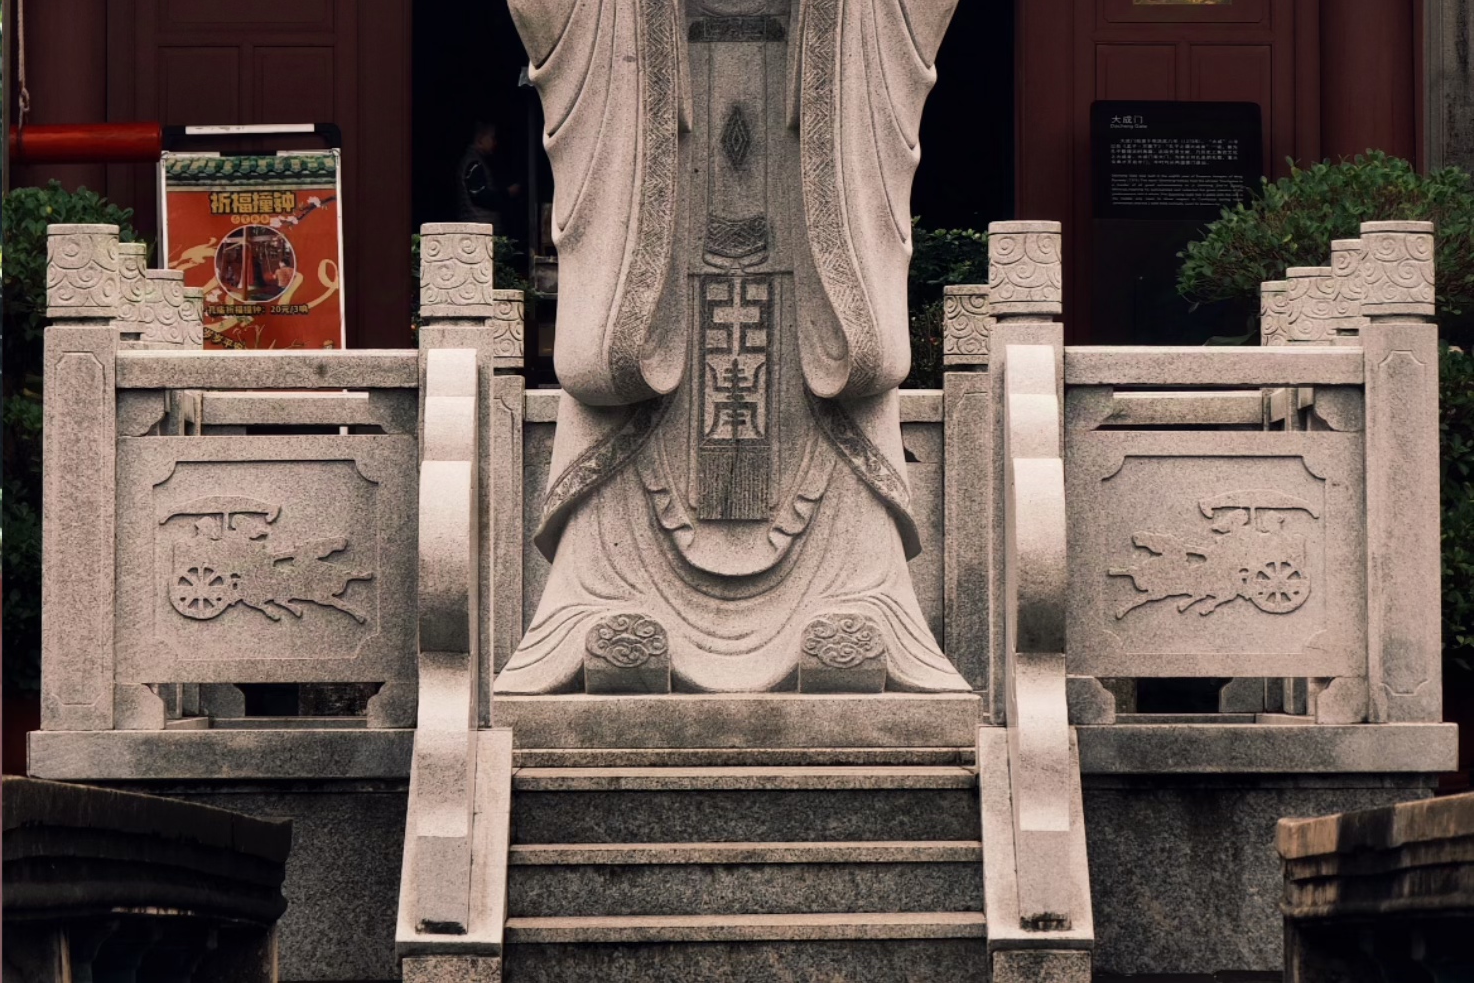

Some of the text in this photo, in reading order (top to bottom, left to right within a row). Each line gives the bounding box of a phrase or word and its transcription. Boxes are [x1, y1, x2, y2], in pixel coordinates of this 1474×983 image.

[1111, 114, 1144, 124] 大成门
[209, 190, 295, 214] 祈福撞钟
